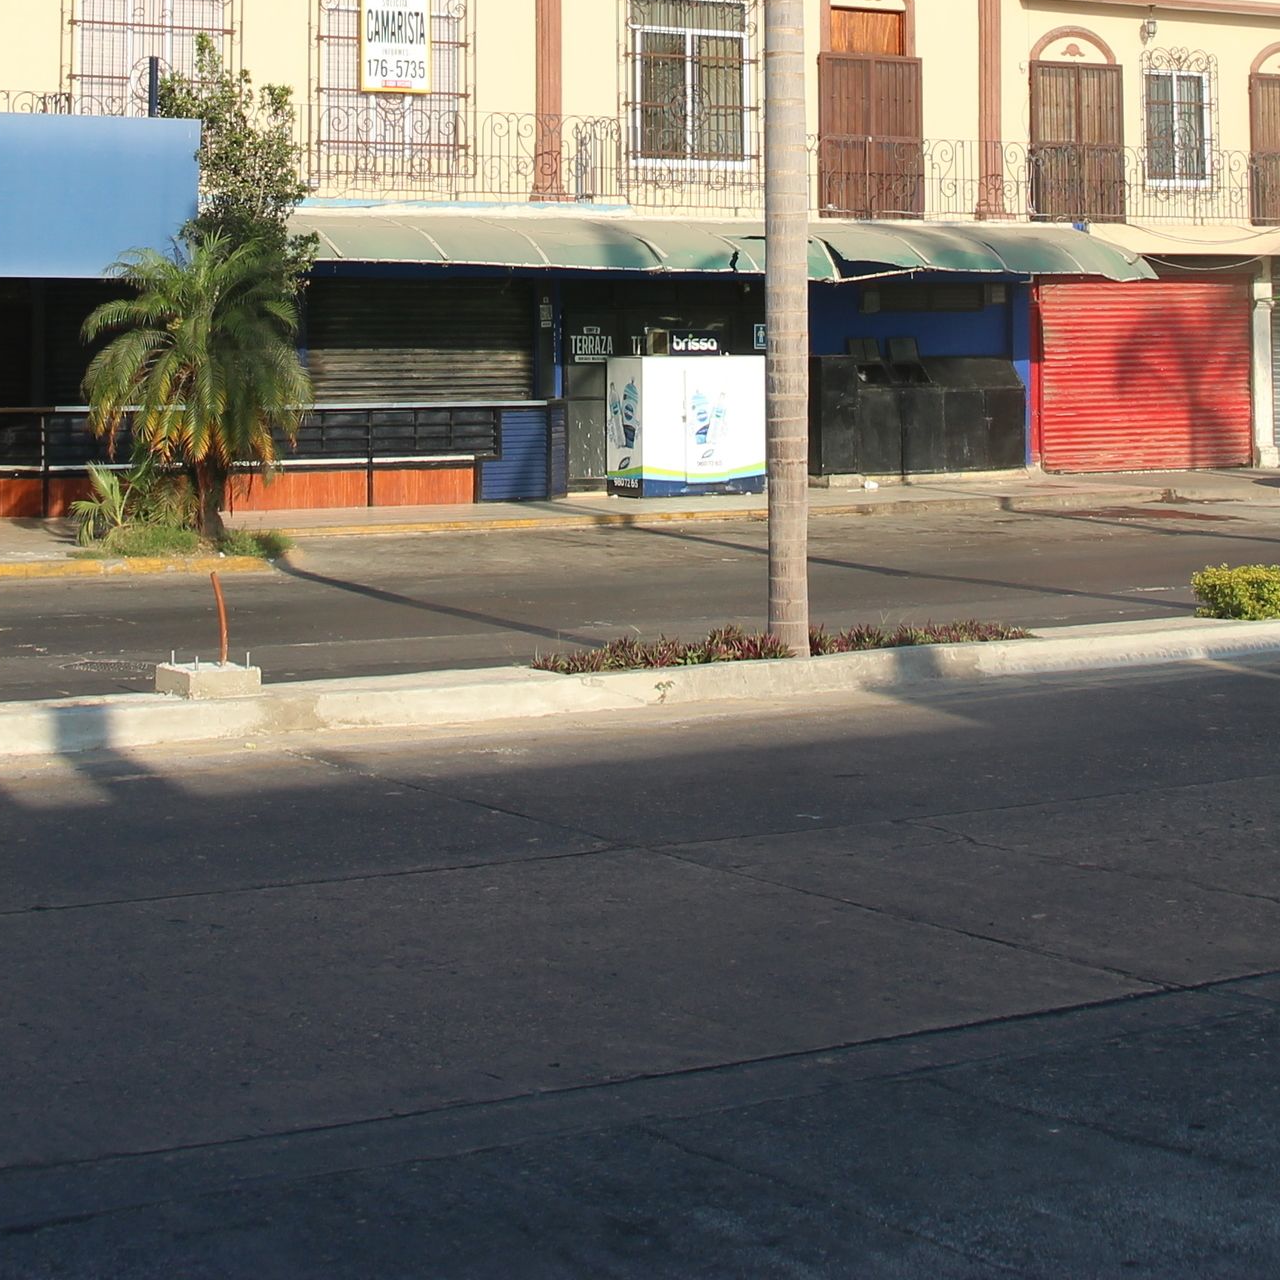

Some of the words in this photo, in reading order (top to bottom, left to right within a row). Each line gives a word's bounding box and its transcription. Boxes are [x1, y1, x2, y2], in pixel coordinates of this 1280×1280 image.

[367, 9, 426, 45] CAMARISTA
[367, 58, 426, 79] 176-5735
[570, 335, 613, 355] TERRAZA
[672, 333, 718, 352] brissa
